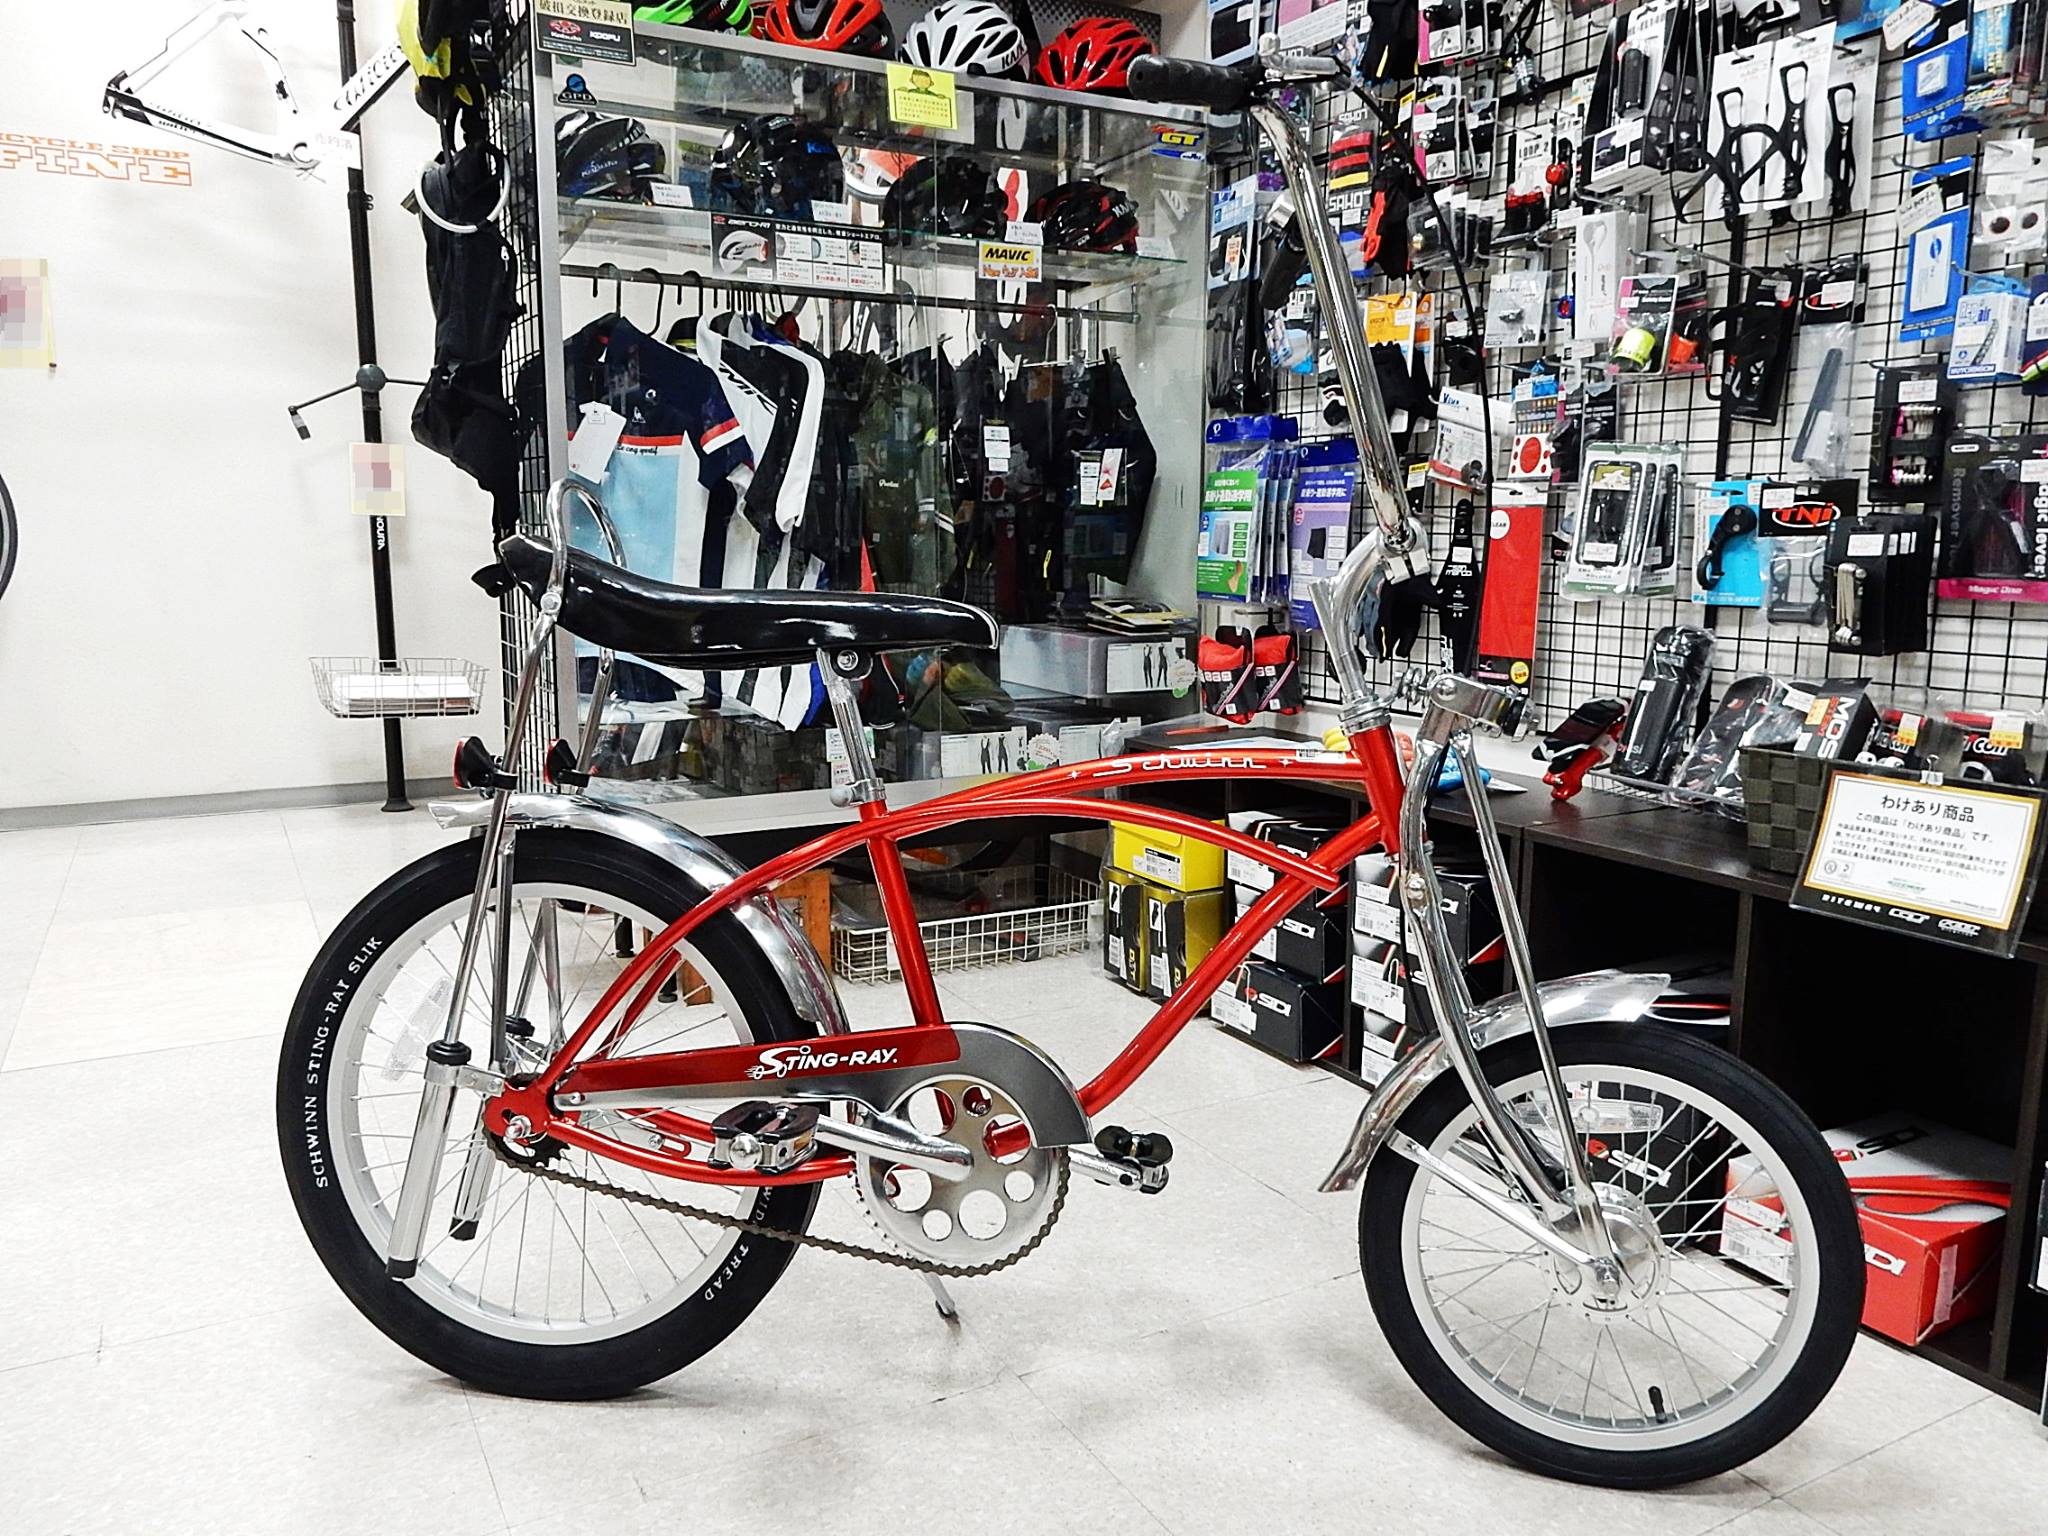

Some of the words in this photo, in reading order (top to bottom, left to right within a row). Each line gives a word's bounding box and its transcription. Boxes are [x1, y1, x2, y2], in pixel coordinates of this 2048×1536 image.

[112, 144, 190, 160] SHOP
[985, 247, 1031, 262] MAVIC
[1093, 753, 1267, 777] Schwinn
[1881, 795, 1975, 822] わけあり商品
[348, 936, 382, 975] SLIK
[308, 978, 350, 1084] STING-RAY
[305, 1095, 328, 1188] SCHWINN
[704, 1244, 749, 1300] TREAD
